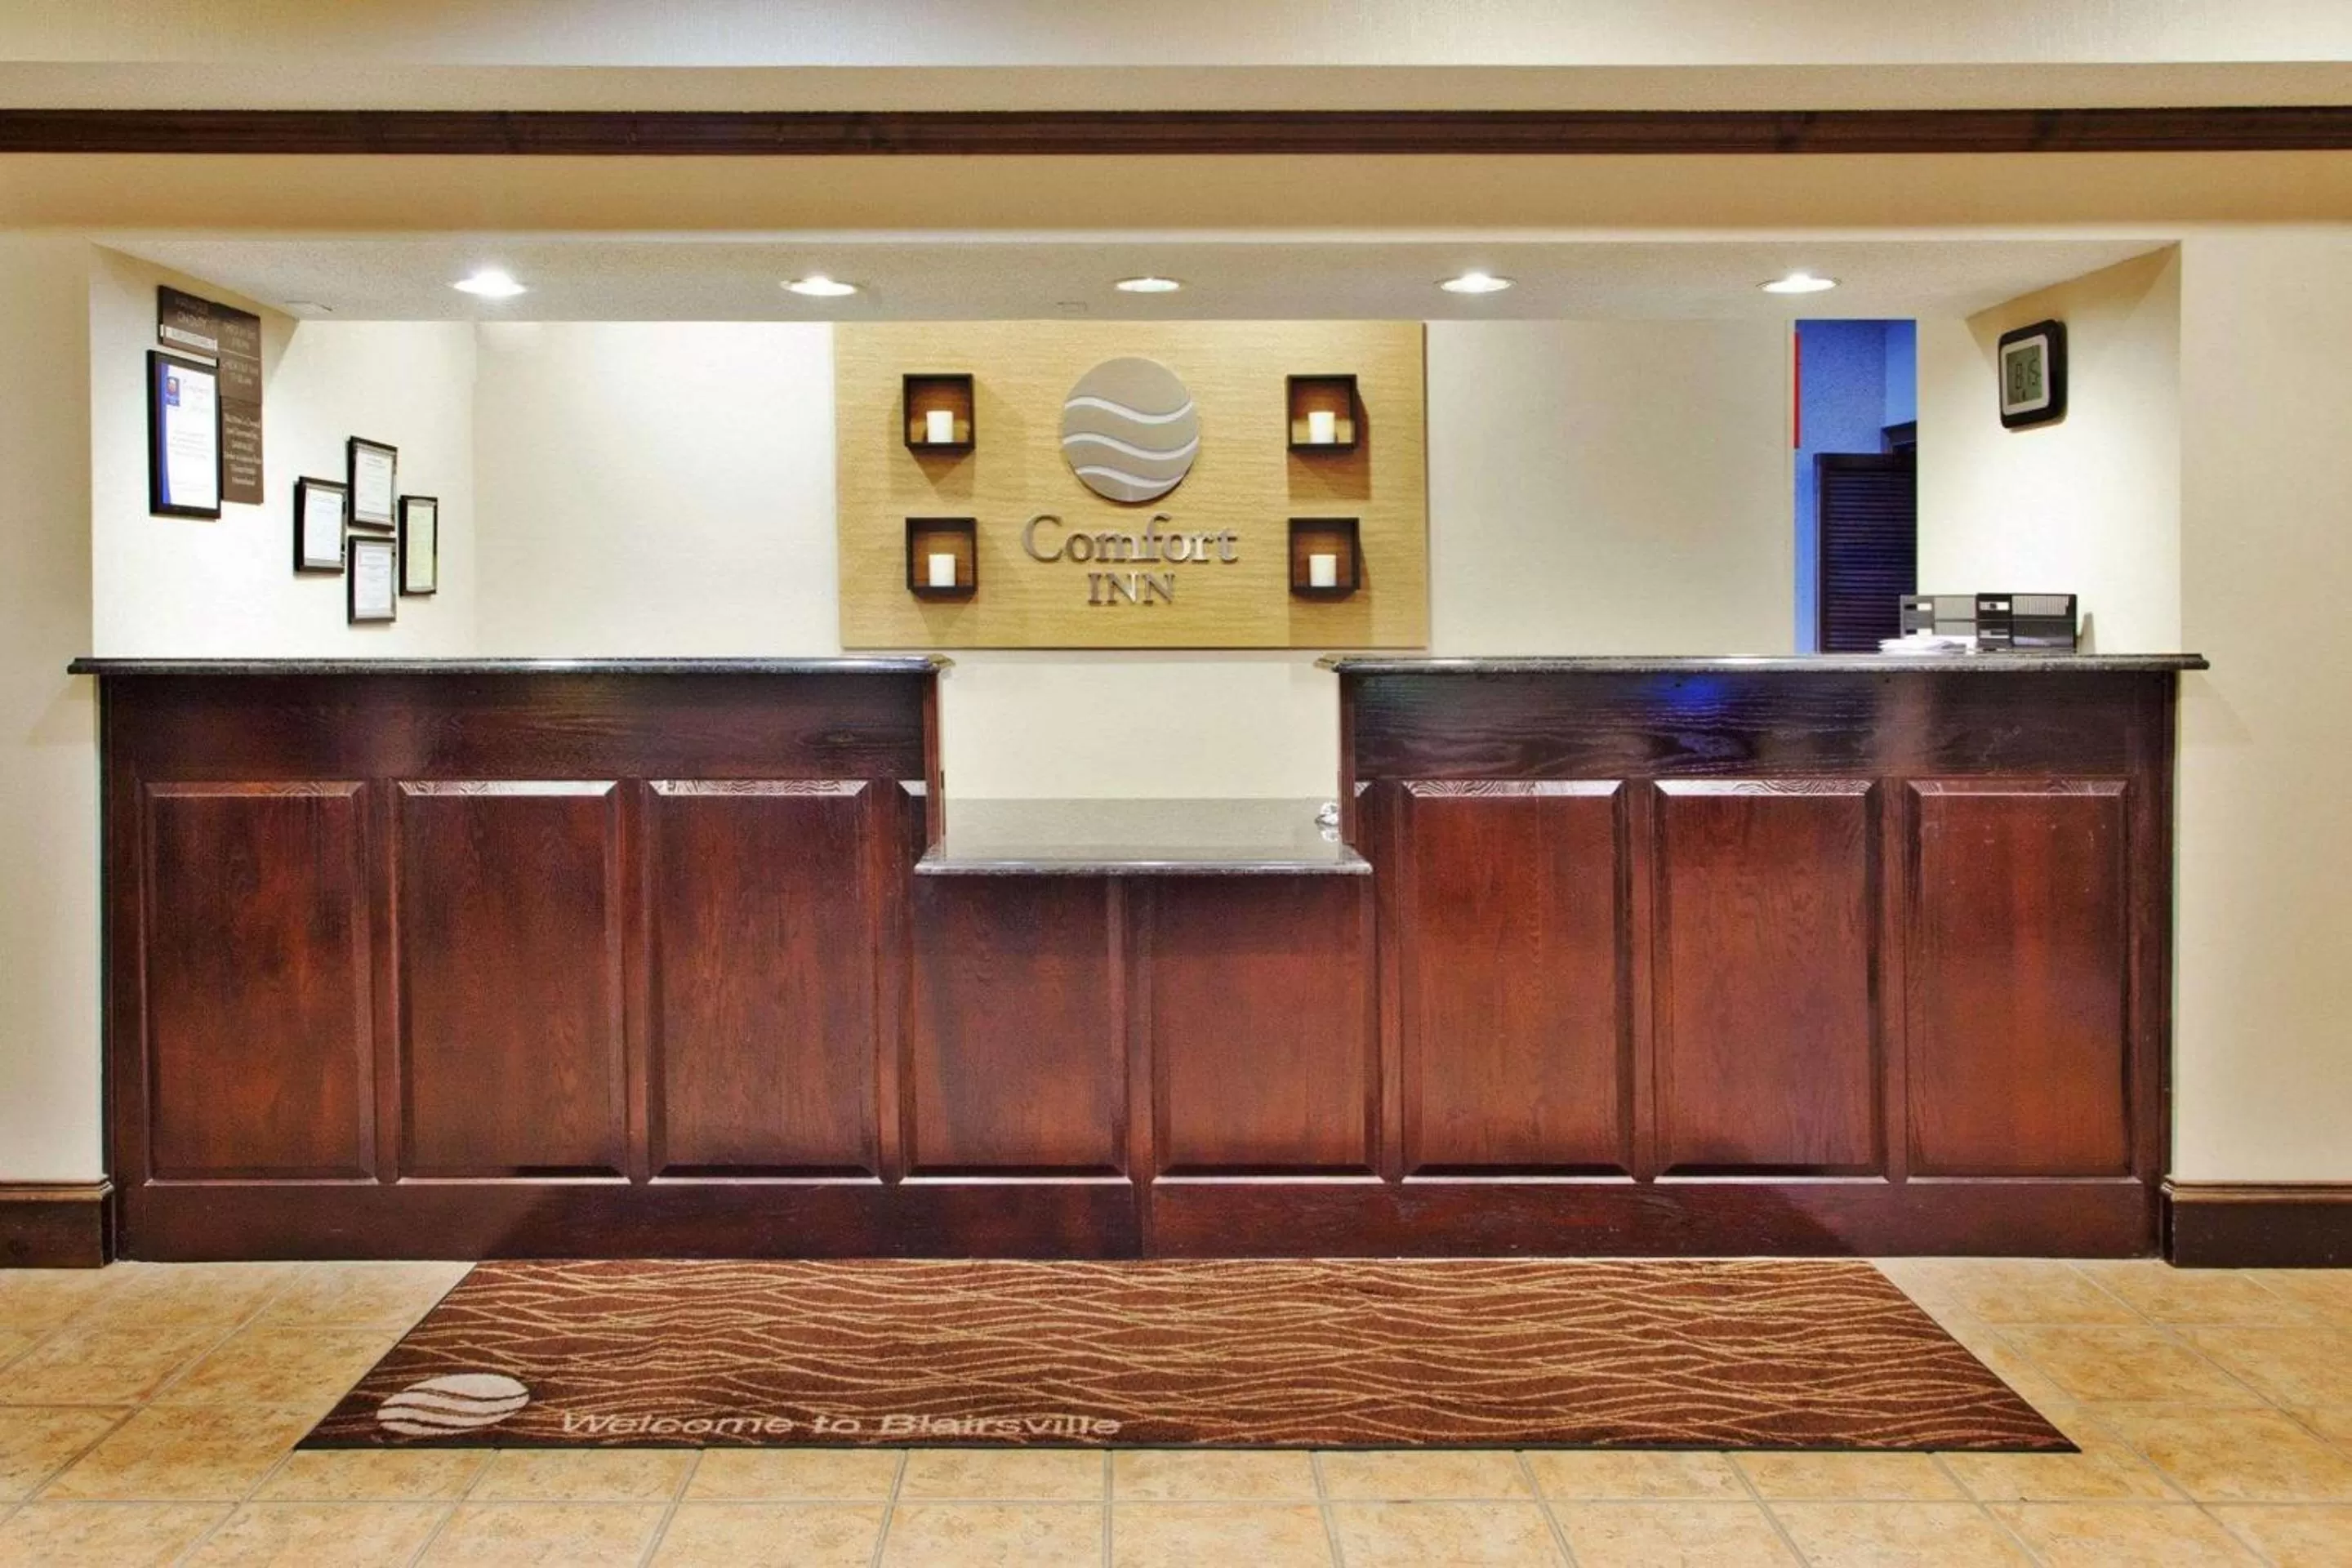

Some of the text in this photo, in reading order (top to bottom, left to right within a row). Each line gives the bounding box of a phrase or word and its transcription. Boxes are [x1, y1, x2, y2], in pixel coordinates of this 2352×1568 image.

[1023, 512, 1239, 564] Comfort
[1088, 570, 1176, 607] INN
[562, 1409, 1122, 1435] Welcome to Blairsville
